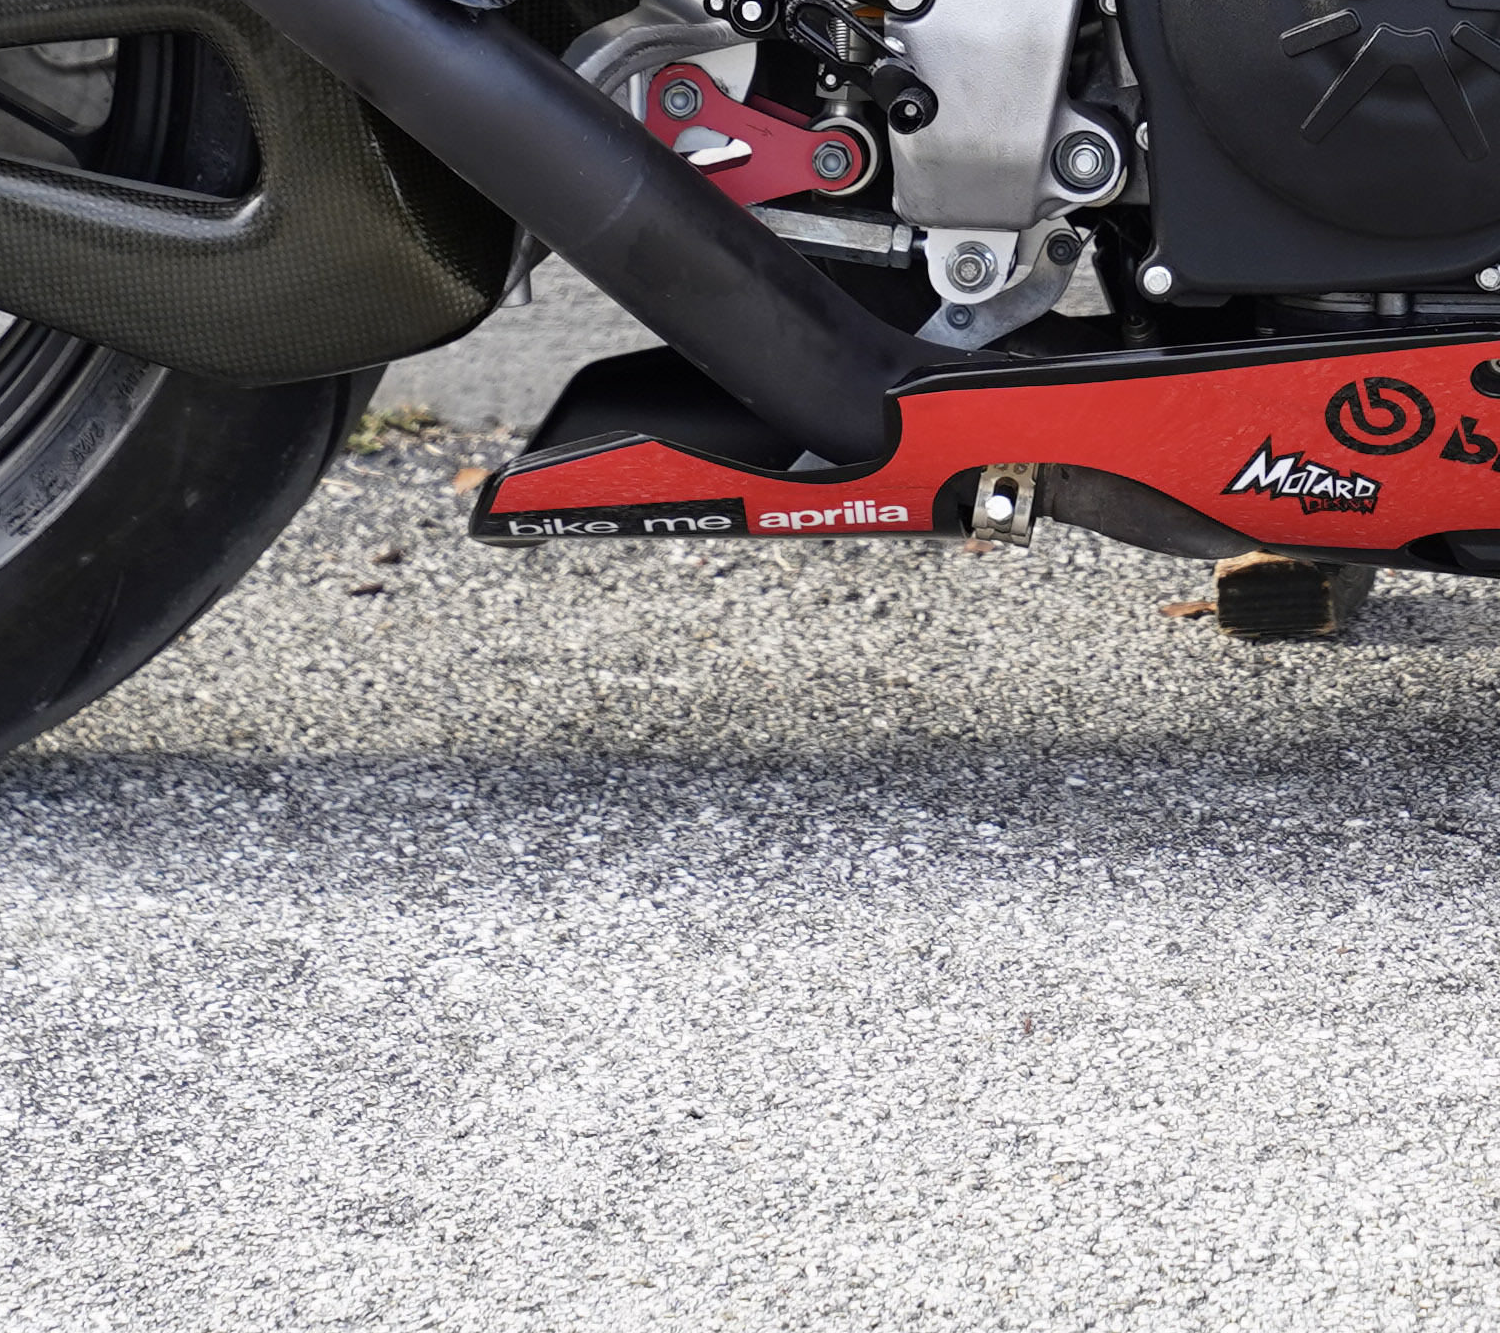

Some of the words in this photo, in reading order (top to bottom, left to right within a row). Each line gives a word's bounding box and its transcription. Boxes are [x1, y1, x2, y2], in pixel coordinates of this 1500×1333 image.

[1231, 450, 1376, 500] MOTARD
[508, 515, 620, 537] bike
[642, 509, 733, 532] me
[758, 501, 909, 533] aprilia
